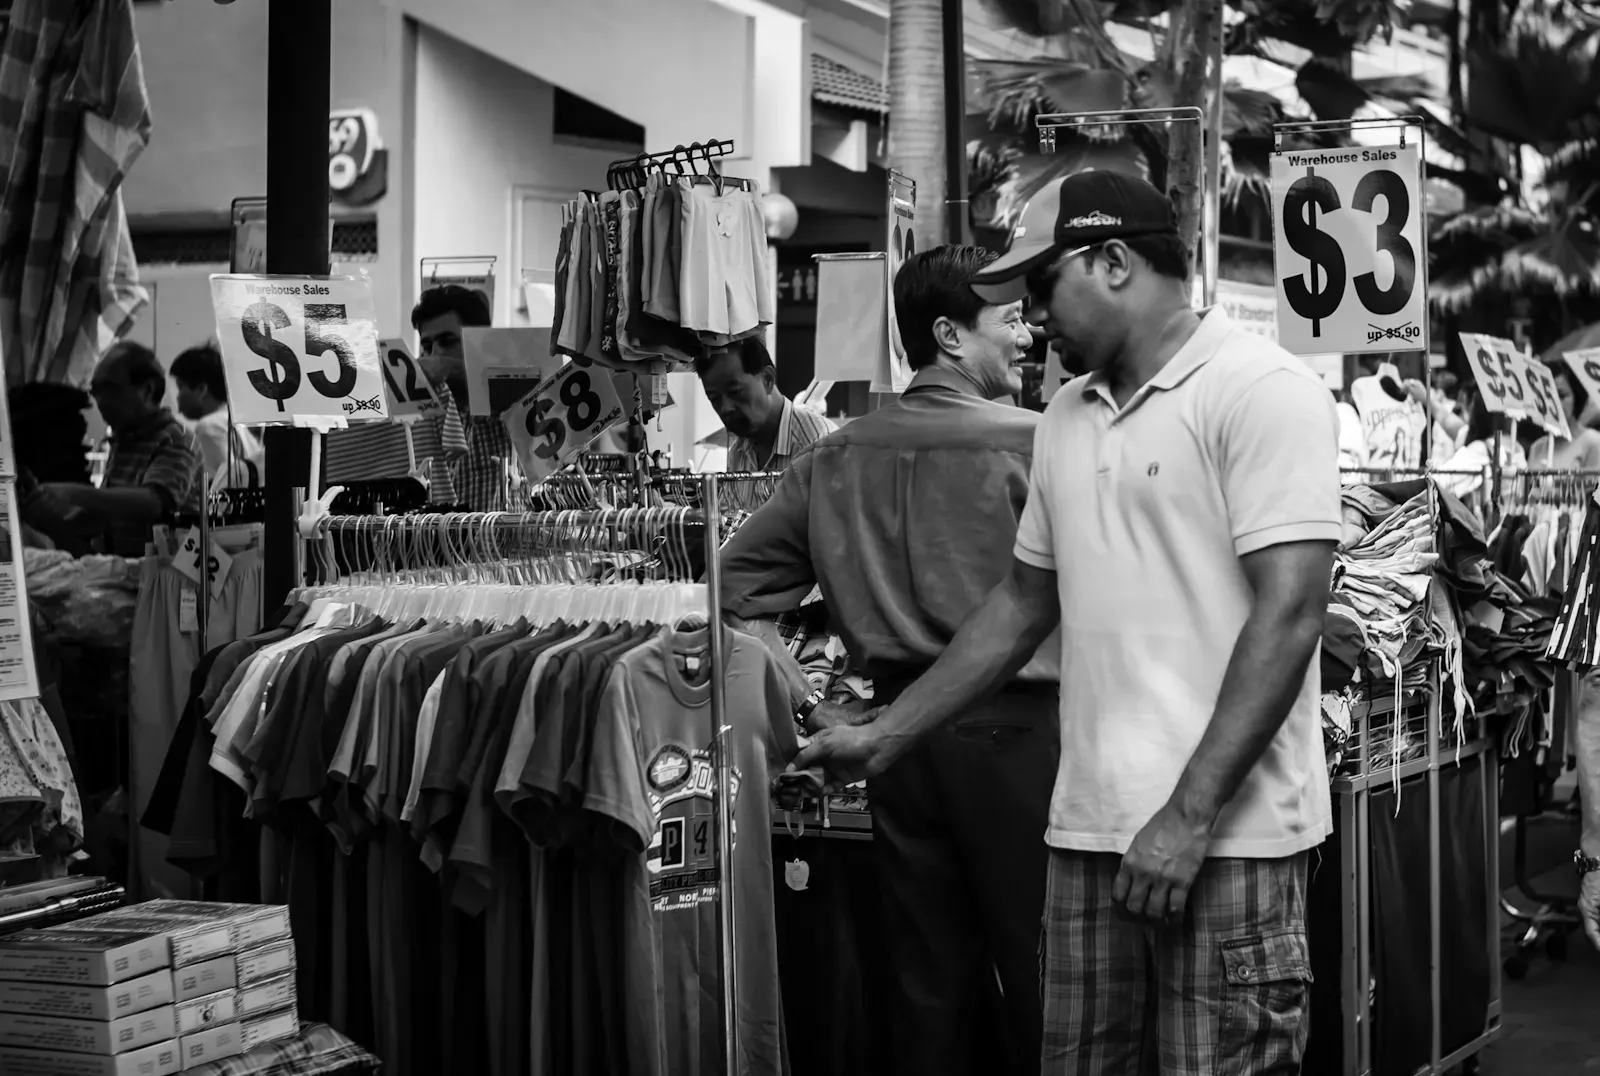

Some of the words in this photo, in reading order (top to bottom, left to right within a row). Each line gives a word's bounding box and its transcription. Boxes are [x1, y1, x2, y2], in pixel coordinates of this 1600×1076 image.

[1288, 153, 1358, 167] Warehouse
[1362, 150, 1397, 162] Sales
[1282, 166, 1416, 338] $3
[245, 283, 300, 295] Warehouse
[303, 284, 330, 295] Sales
[241, 296, 357, 412] $5
[1367, 330, 1383, 342] up
[1476, 346, 1524, 405] $5
[342, 402, 354, 413] up
[525, 369, 602, 461] $8
